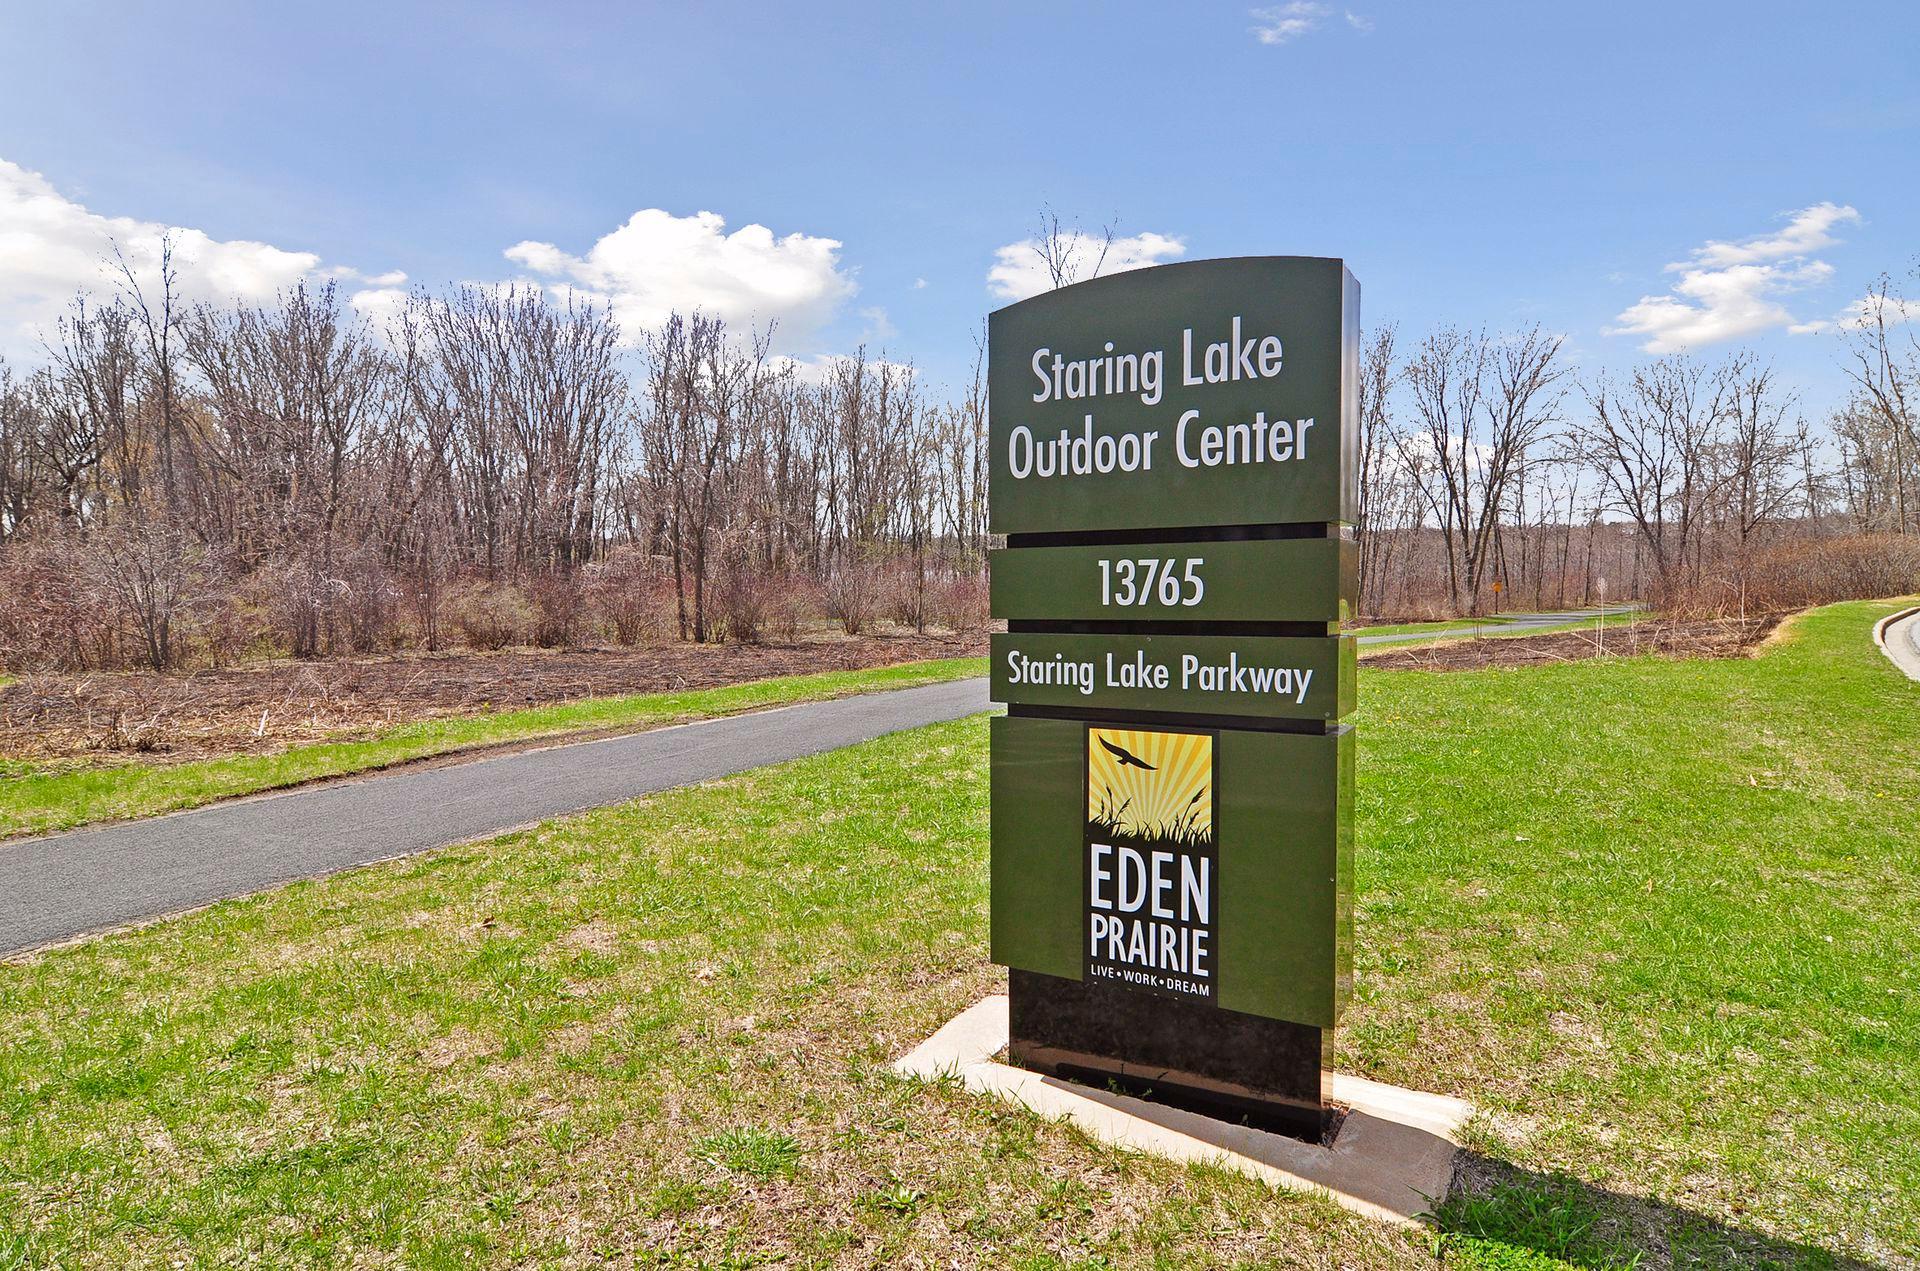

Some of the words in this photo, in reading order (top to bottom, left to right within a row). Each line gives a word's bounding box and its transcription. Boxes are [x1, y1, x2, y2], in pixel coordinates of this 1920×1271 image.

[1031, 341, 1164, 406] Staring
[1183, 316, 1283, 386] Lake
[1008, 414, 1159, 480] Outdoor
[1175, 409, 1314, 468] Center
[1098, 557, 1205, 607] 13765
[1007, 650, 1094, 695] Staring
[1106, 650, 1169, 690] Lake
[1182, 651, 1313, 704] Parkway
[1091, 843, 1209, 925] EDEN
[1091, 912, 1209, 977] PRAIRIE
